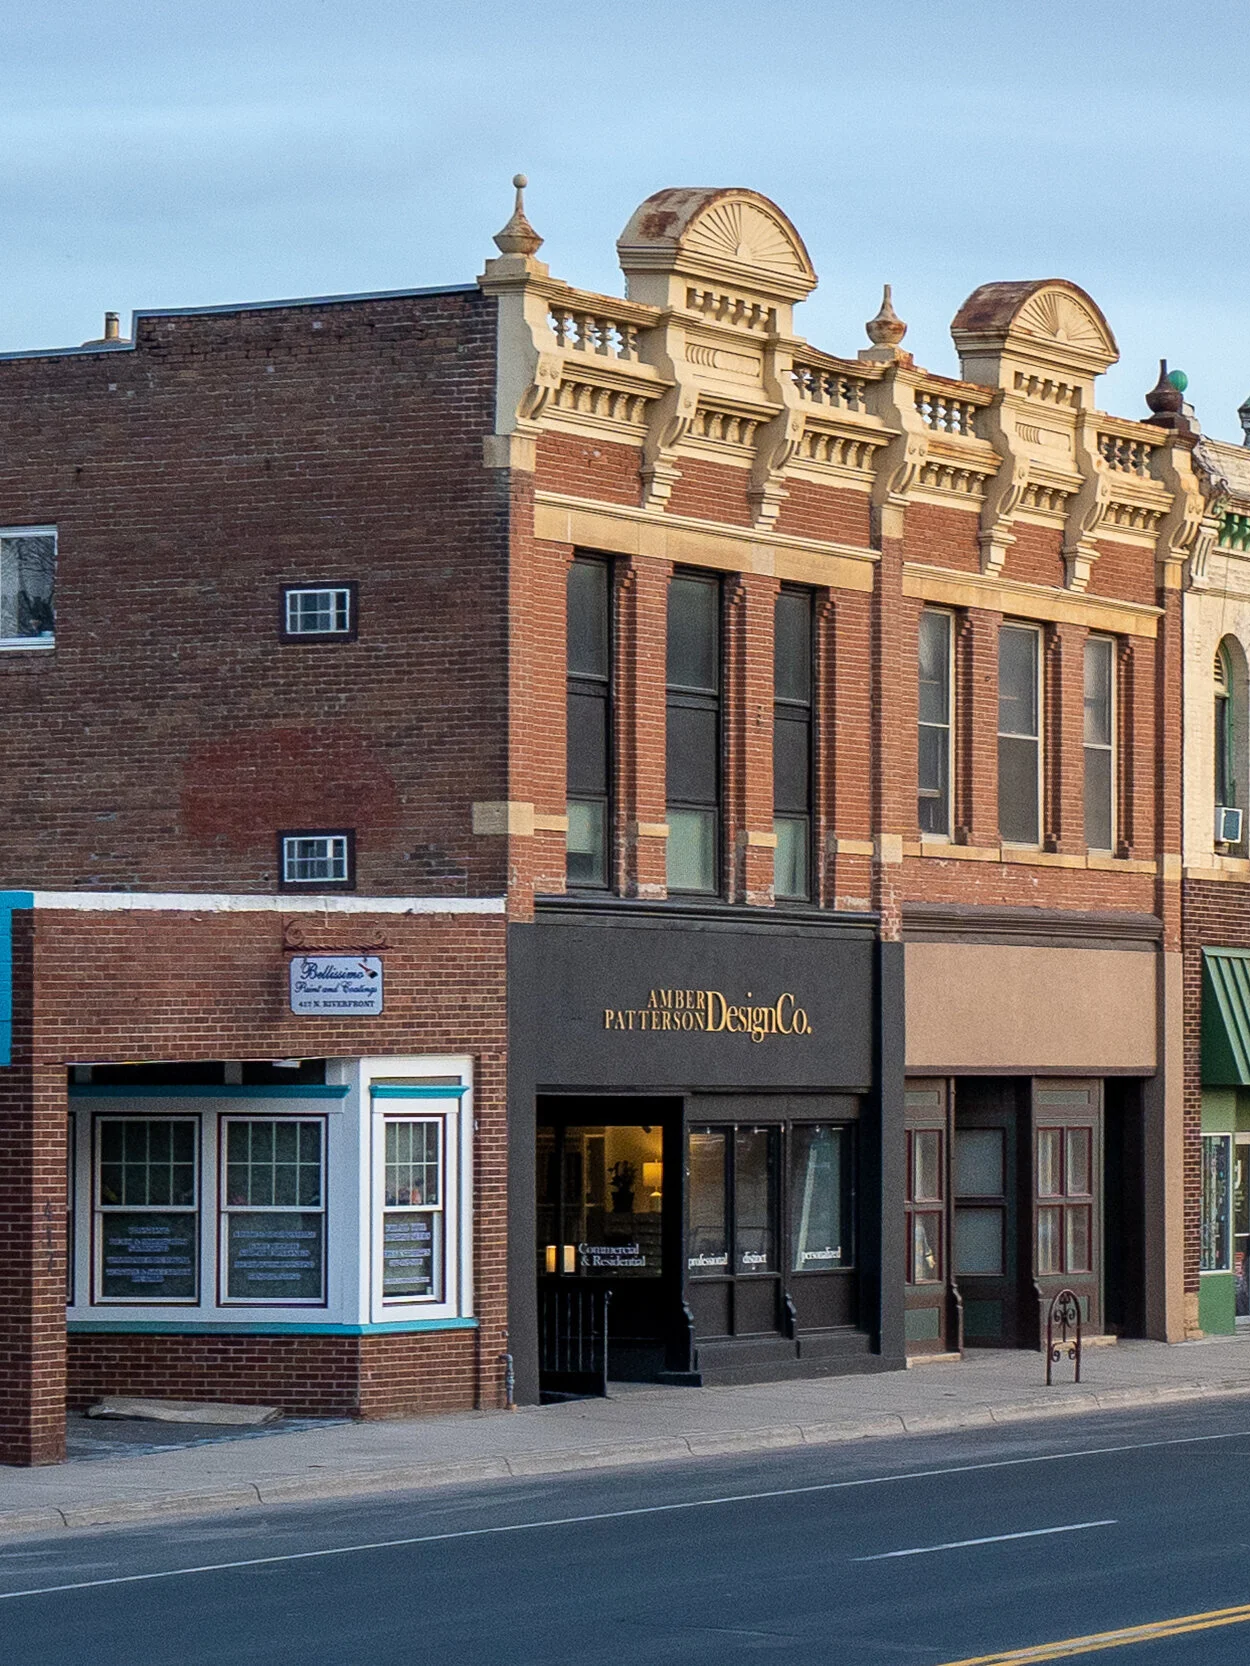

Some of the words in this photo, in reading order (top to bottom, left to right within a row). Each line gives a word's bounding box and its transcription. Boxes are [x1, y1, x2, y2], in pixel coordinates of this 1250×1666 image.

[300, 962, 364, 979] Bellissimo
[295, 981, 321, 993] Paint
[322, 984, 339, 993] and
[340, 980, 378, 997] Coatings
[323, 1000, 375, 1008] RIVERFRONT
[647, 989, 706, 1010] AMBER
[603, 1009, 706, 1031] PATTERSON
[578, 1243, 640, 1255] Commercial
[801, 1245, 841, 1263] personalized
[581, 1255, 591, 1266] &
[592, 1255, 646, 1266] Residential
[687, 1252, 728, 1269] professional
